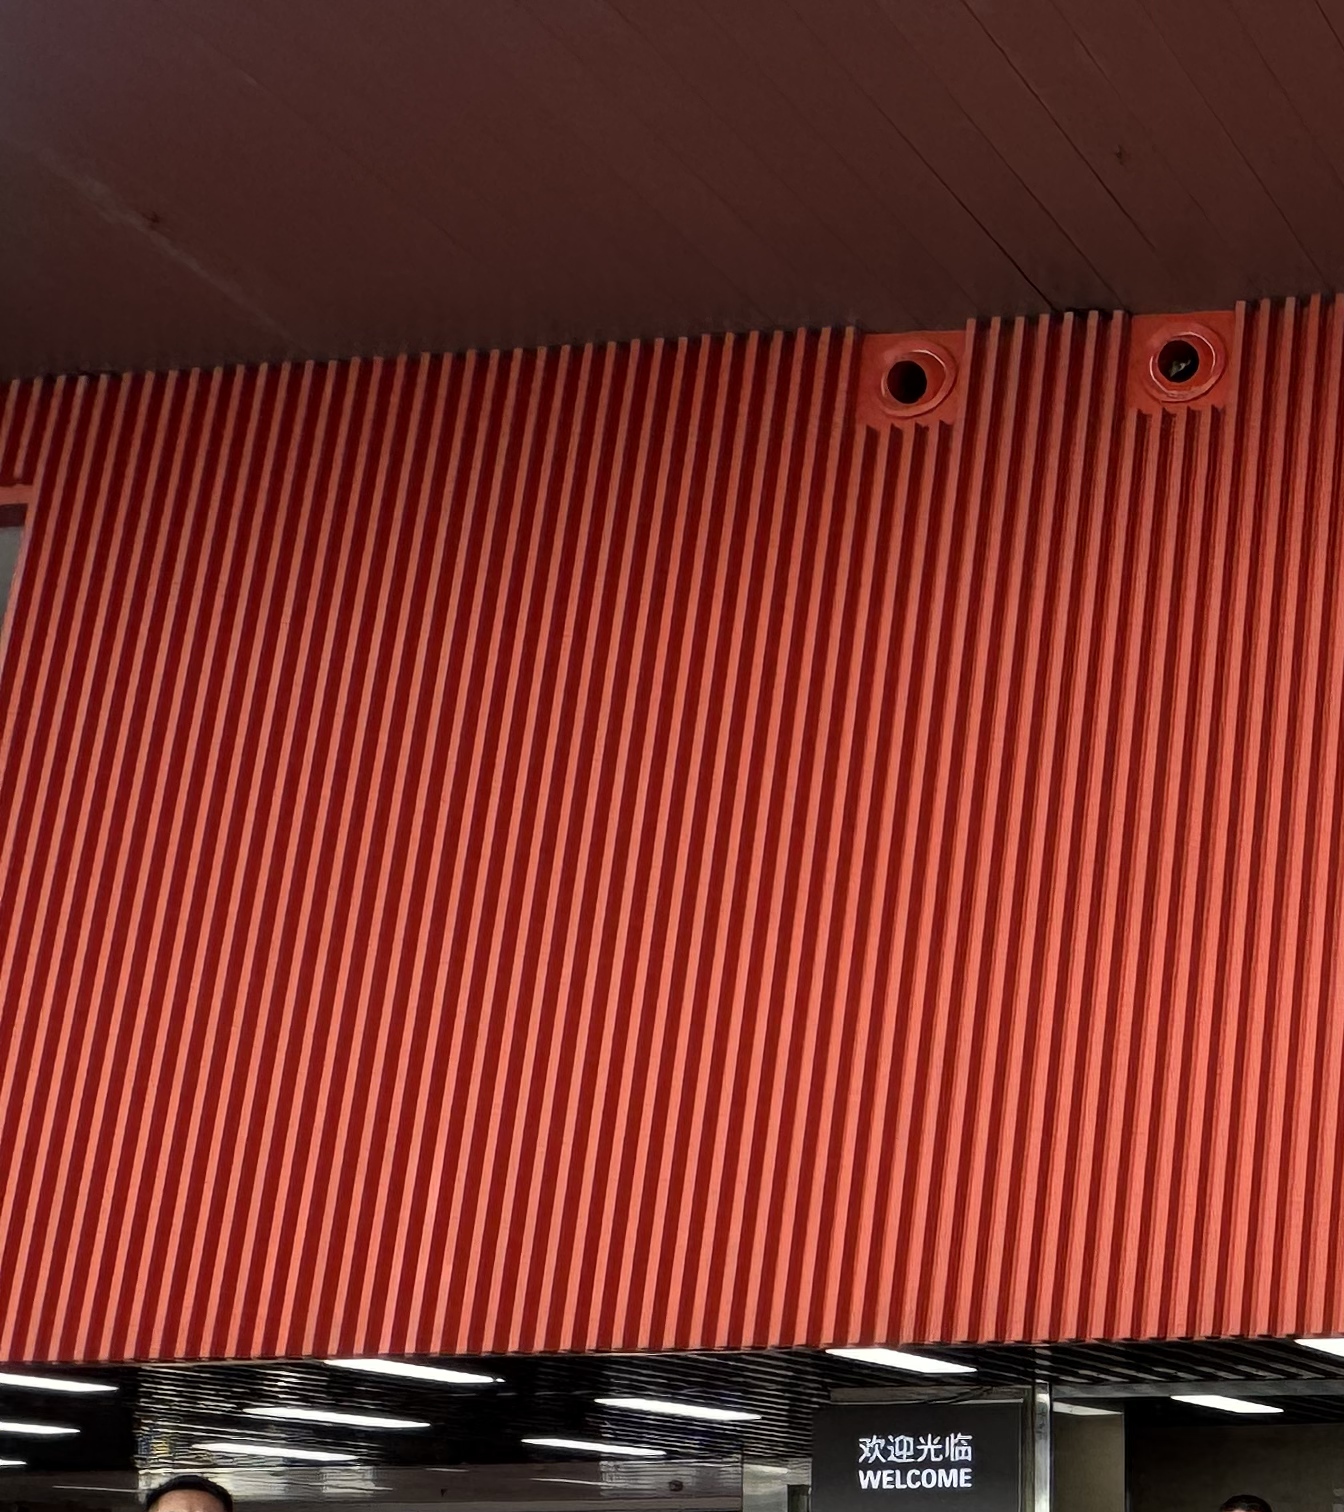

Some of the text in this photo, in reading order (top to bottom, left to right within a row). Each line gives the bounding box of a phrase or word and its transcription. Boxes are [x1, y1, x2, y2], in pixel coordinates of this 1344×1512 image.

[858, 1432, 973, 1464] 欢迎光临
[858, 1467, 973, 1490] WELCOME
